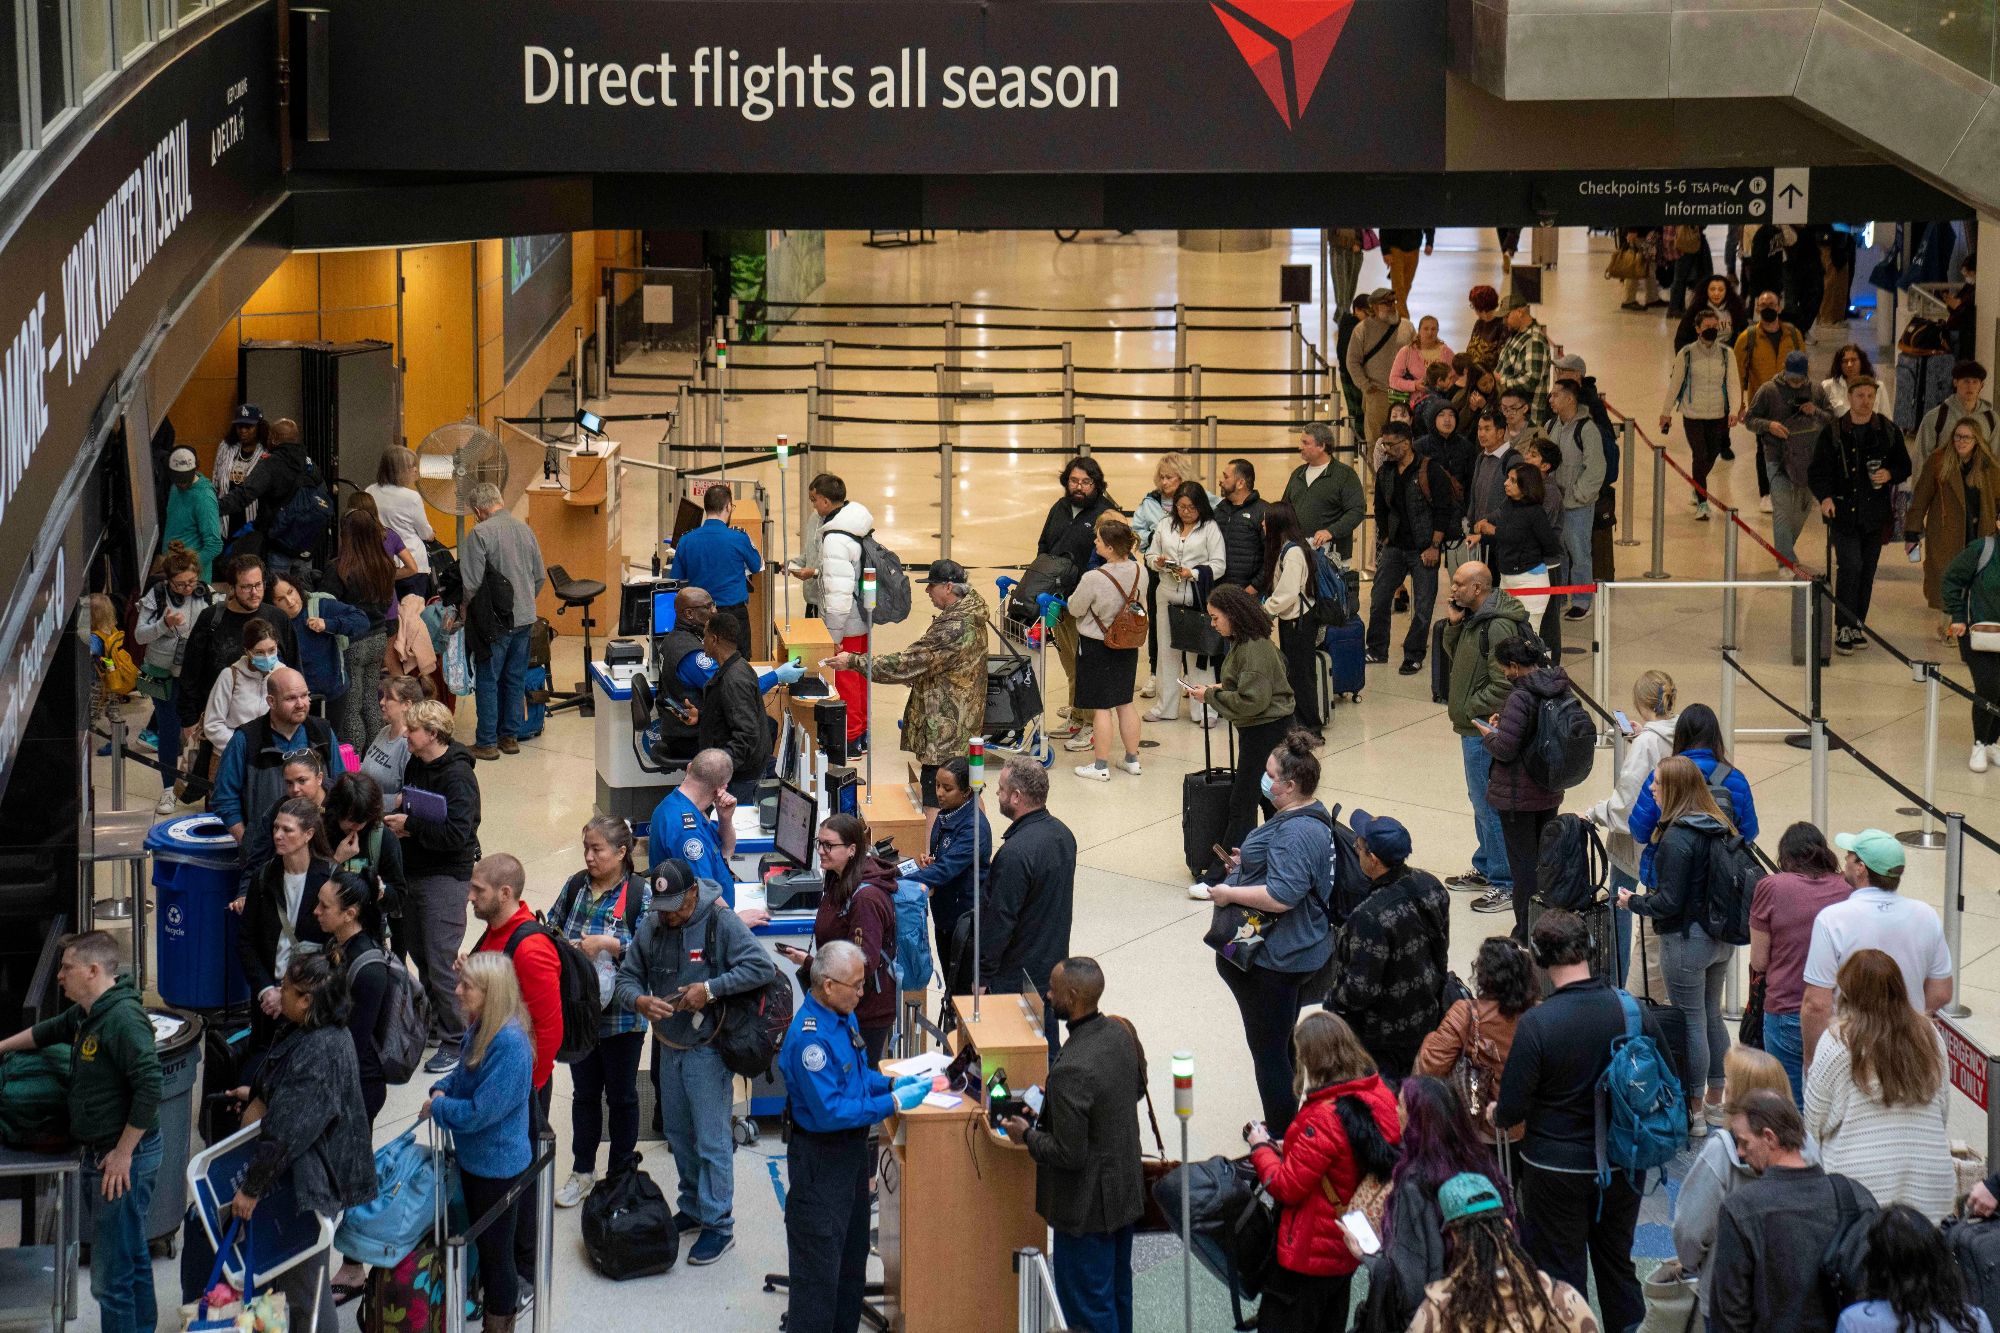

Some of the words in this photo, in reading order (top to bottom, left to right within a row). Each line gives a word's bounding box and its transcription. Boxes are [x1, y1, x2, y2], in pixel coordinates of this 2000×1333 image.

[525, 45, 678, 107] Direct
[690, 46, 856, 122] flights
[869, 47, 926, 109] all
[943, 65, 1119, 109] season
[217, 114, 239, 157] DELTA
[1579, 180, 1660, 198] Checkpoints
[1664, 180, 1687, 194] 5-6
[1690, 183, 1710, 193] TSA
[1665, 201, 1743, 216] Information
[62, 225, 99, 387] YOUR
[97, 168, 145, 330] WINTER
[143, 151, 157, 264] IN
[156, 119, 193, 247] SEOUL
[165, 924, 185, 937] Recycle
[1961, 1067, 1985, 1104] ONLY
